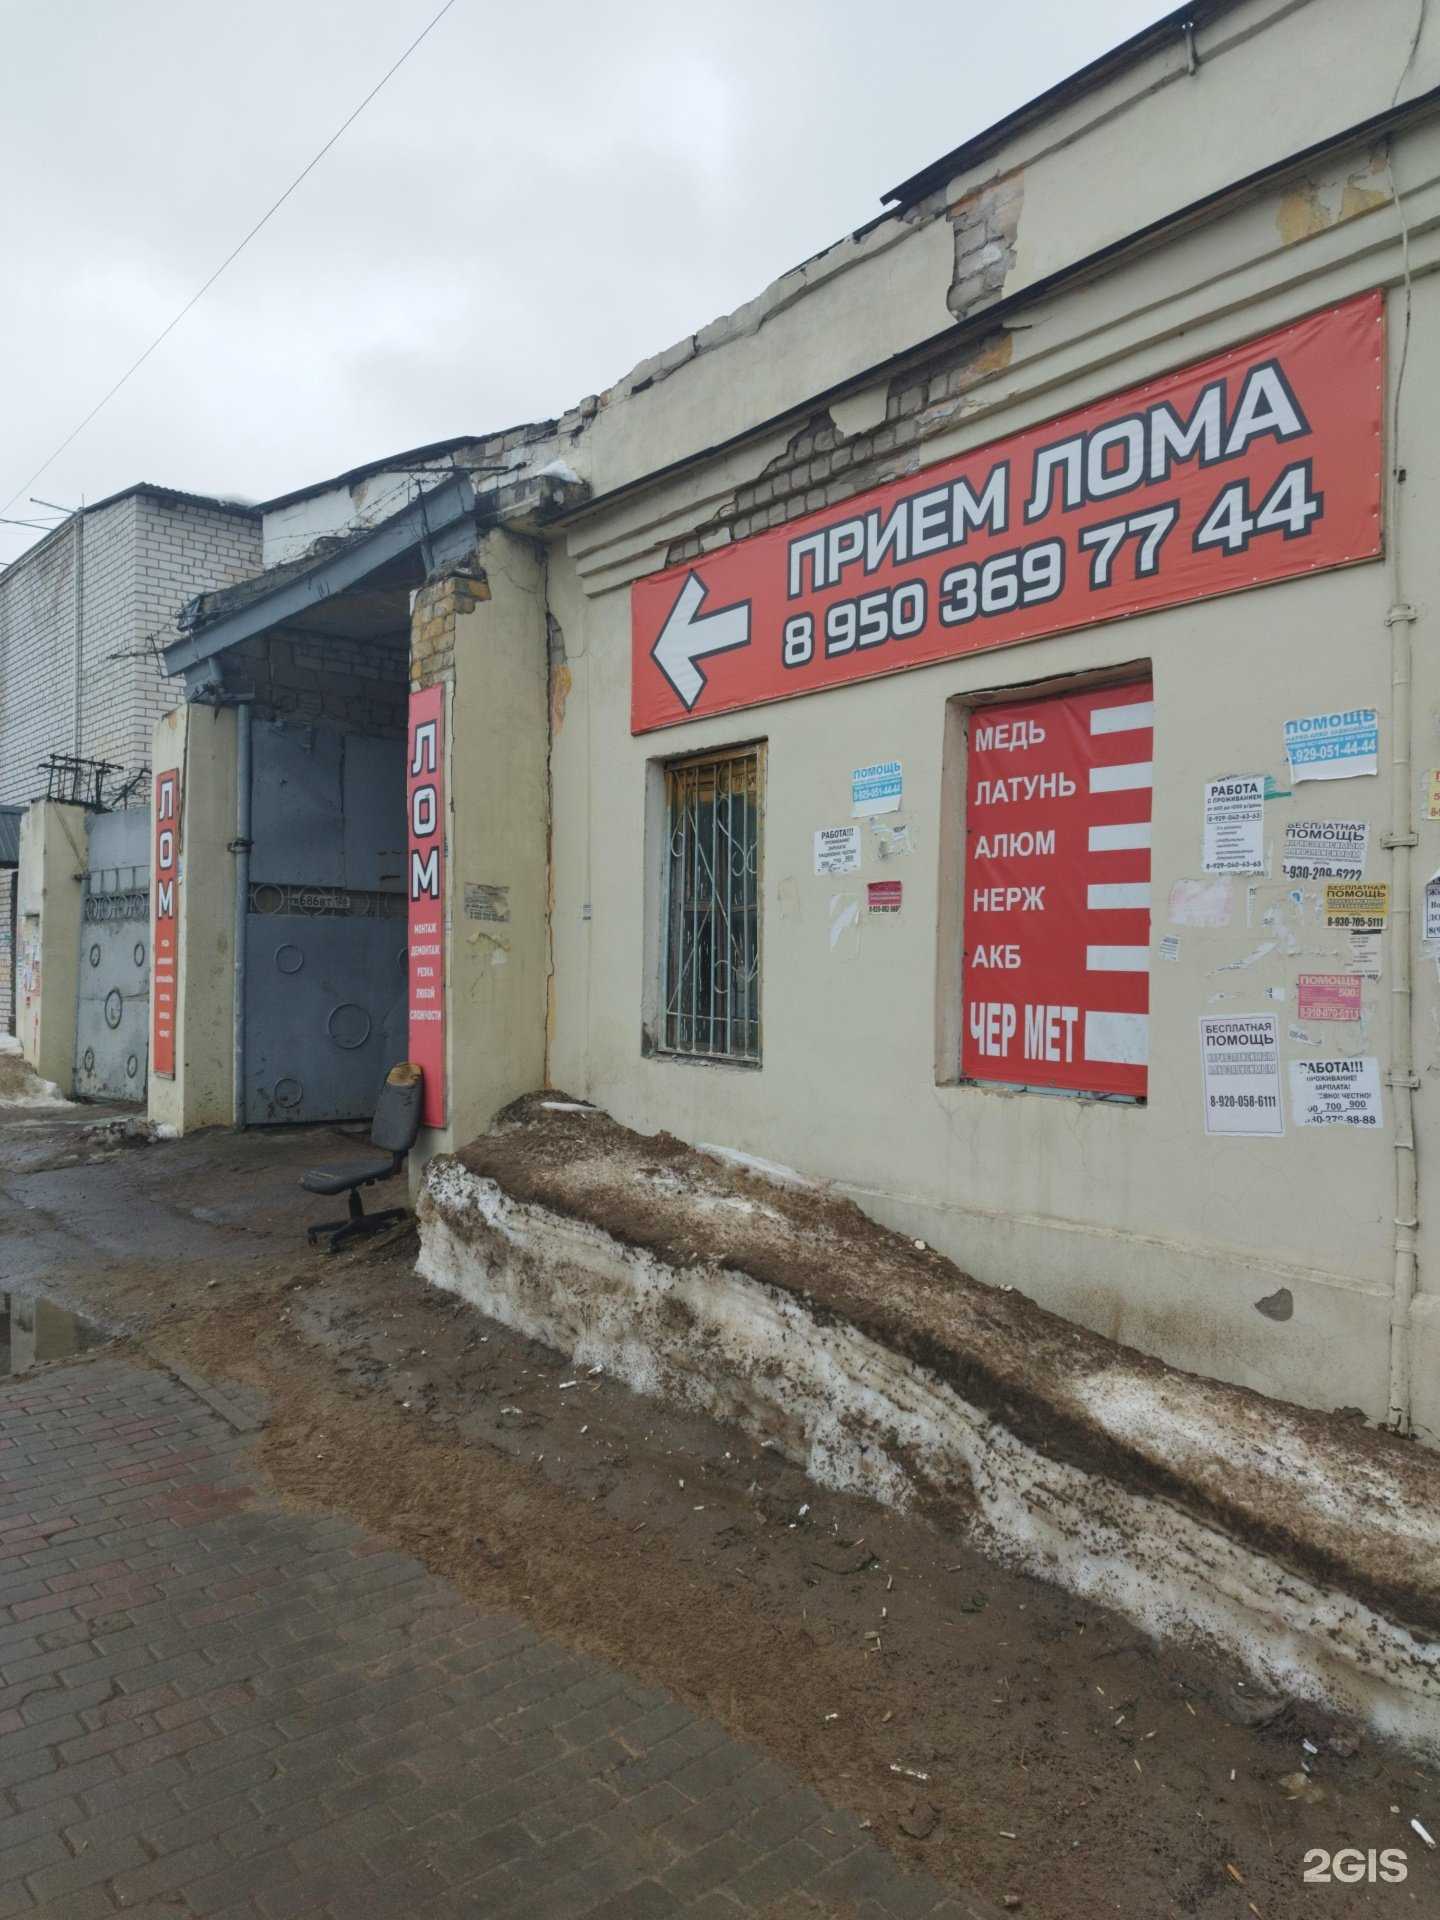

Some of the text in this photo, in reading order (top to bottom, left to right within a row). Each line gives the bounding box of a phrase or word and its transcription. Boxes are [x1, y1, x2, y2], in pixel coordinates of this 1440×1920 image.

[787, 358, 1311, 599] ПРИЕМ ЛОМА
[782, 457, 1324, 669] 8 950 369 77 44
[1286, 709, 1376, 734] ПОМОЩЬ
[975, 719, 1046, 752] МЕДЬ
[1292, 738, 1377, 764] -929-051-44-44
[853, 761, 901, 779] ПОМОЩЬ
[974, 772, 1076, 806] ЛАТУНЬ
[1211, 783, 1258, 797] РАБОТА
[411, 719, 440, 902] ЛОМ
[974, 830, 1055, 859] АЛЮМ
[1286, 828, 1365, 843] ПОМОЩЬ
[157, 779, 174, 920] ЛОМ
[973, 886, 1046, 912] НЕРЖ
[1327, 890, 1386, 898] ПОМОЩЬ
[972, 945, 1022, 969] АКБ
[970, 1002, 1079, 1062] ЧЕР МЕТ
[1205, 1022, 1272, 1034] БЕСПЛАТНАЯ
[1206, 1033, 1274, 1047] ПОМОЩЬ
